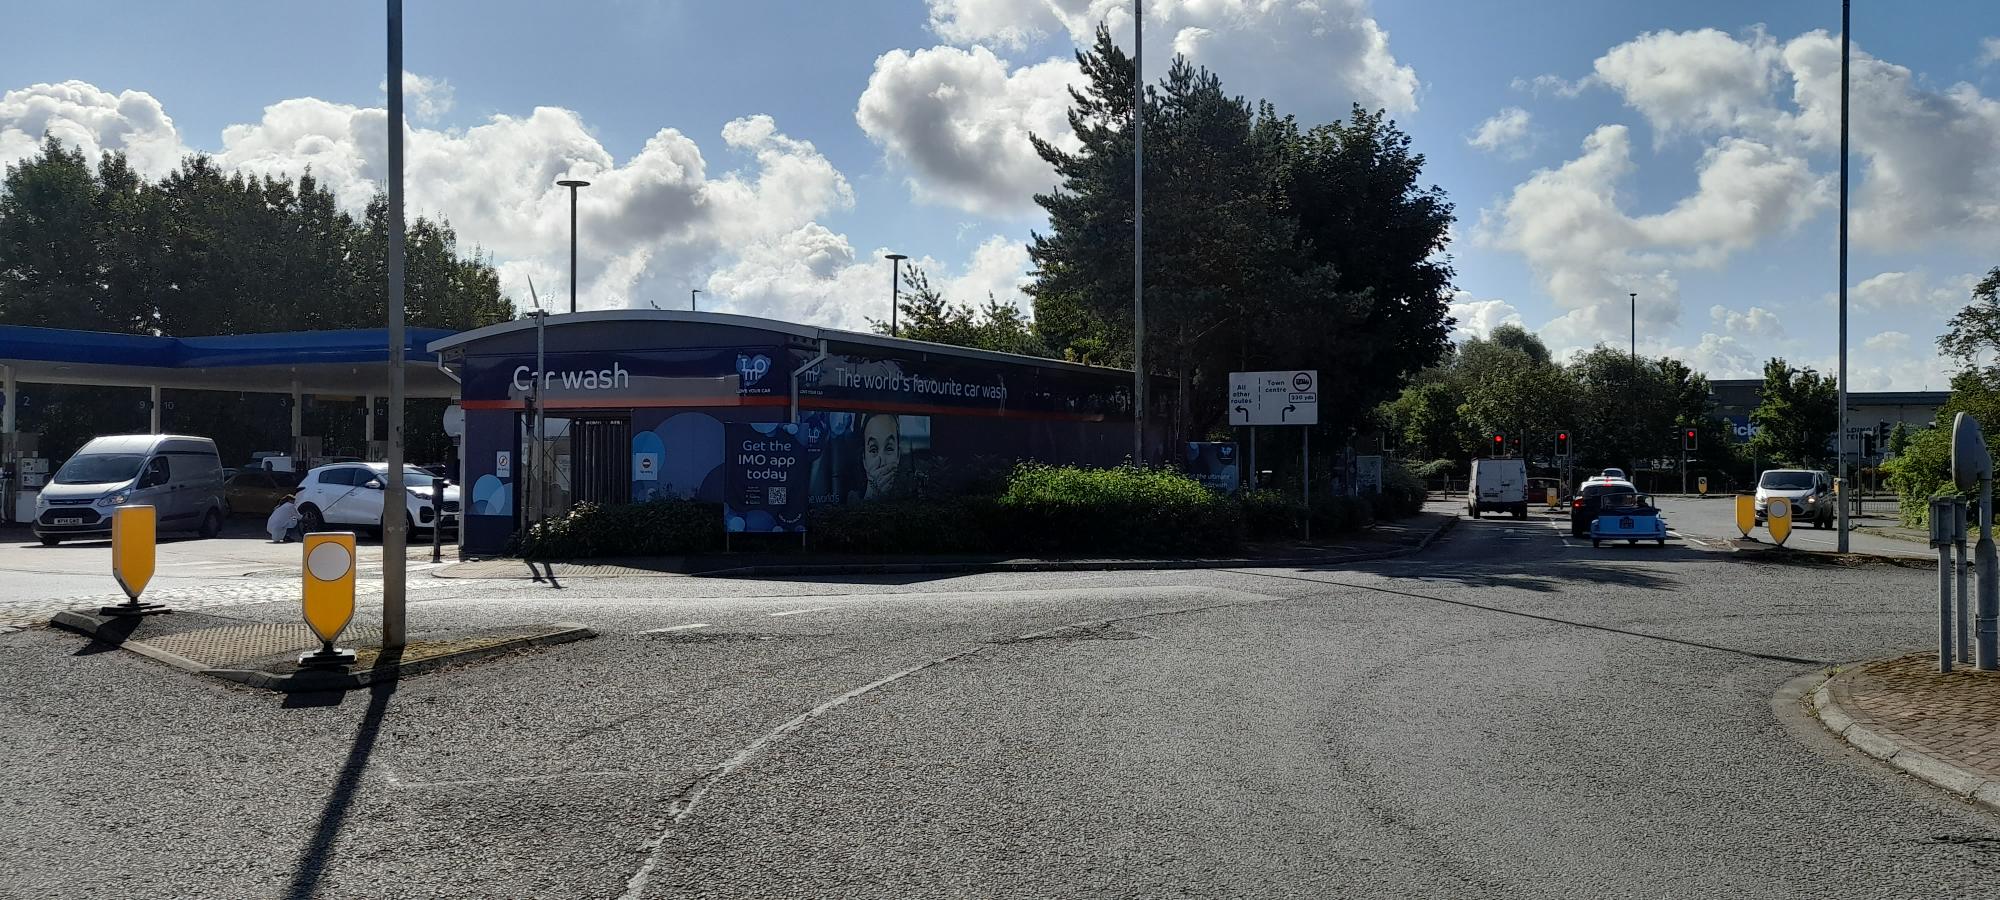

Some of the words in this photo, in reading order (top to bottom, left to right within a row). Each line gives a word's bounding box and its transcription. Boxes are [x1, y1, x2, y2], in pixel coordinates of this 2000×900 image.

[513, 365, 556, 391] Car
[561, 361, 630, 390] wash
[835, 367, 861, 389] The
[864, 371, 910, 392] world's
[912, 373, 962, 396] favourite
[964, 382, 981, 398] car
[982, 375, 1008, 400] wash
[23, 396, 30, 407] 2
[164, 401, 174, 410] 10
[742, 440, 767, 451] Get
[769, 440, 792, 451] the
[738, 454, 766, 466] IMO
[769, 457, 796, 468] app
[747, 467, 787, 482] today
